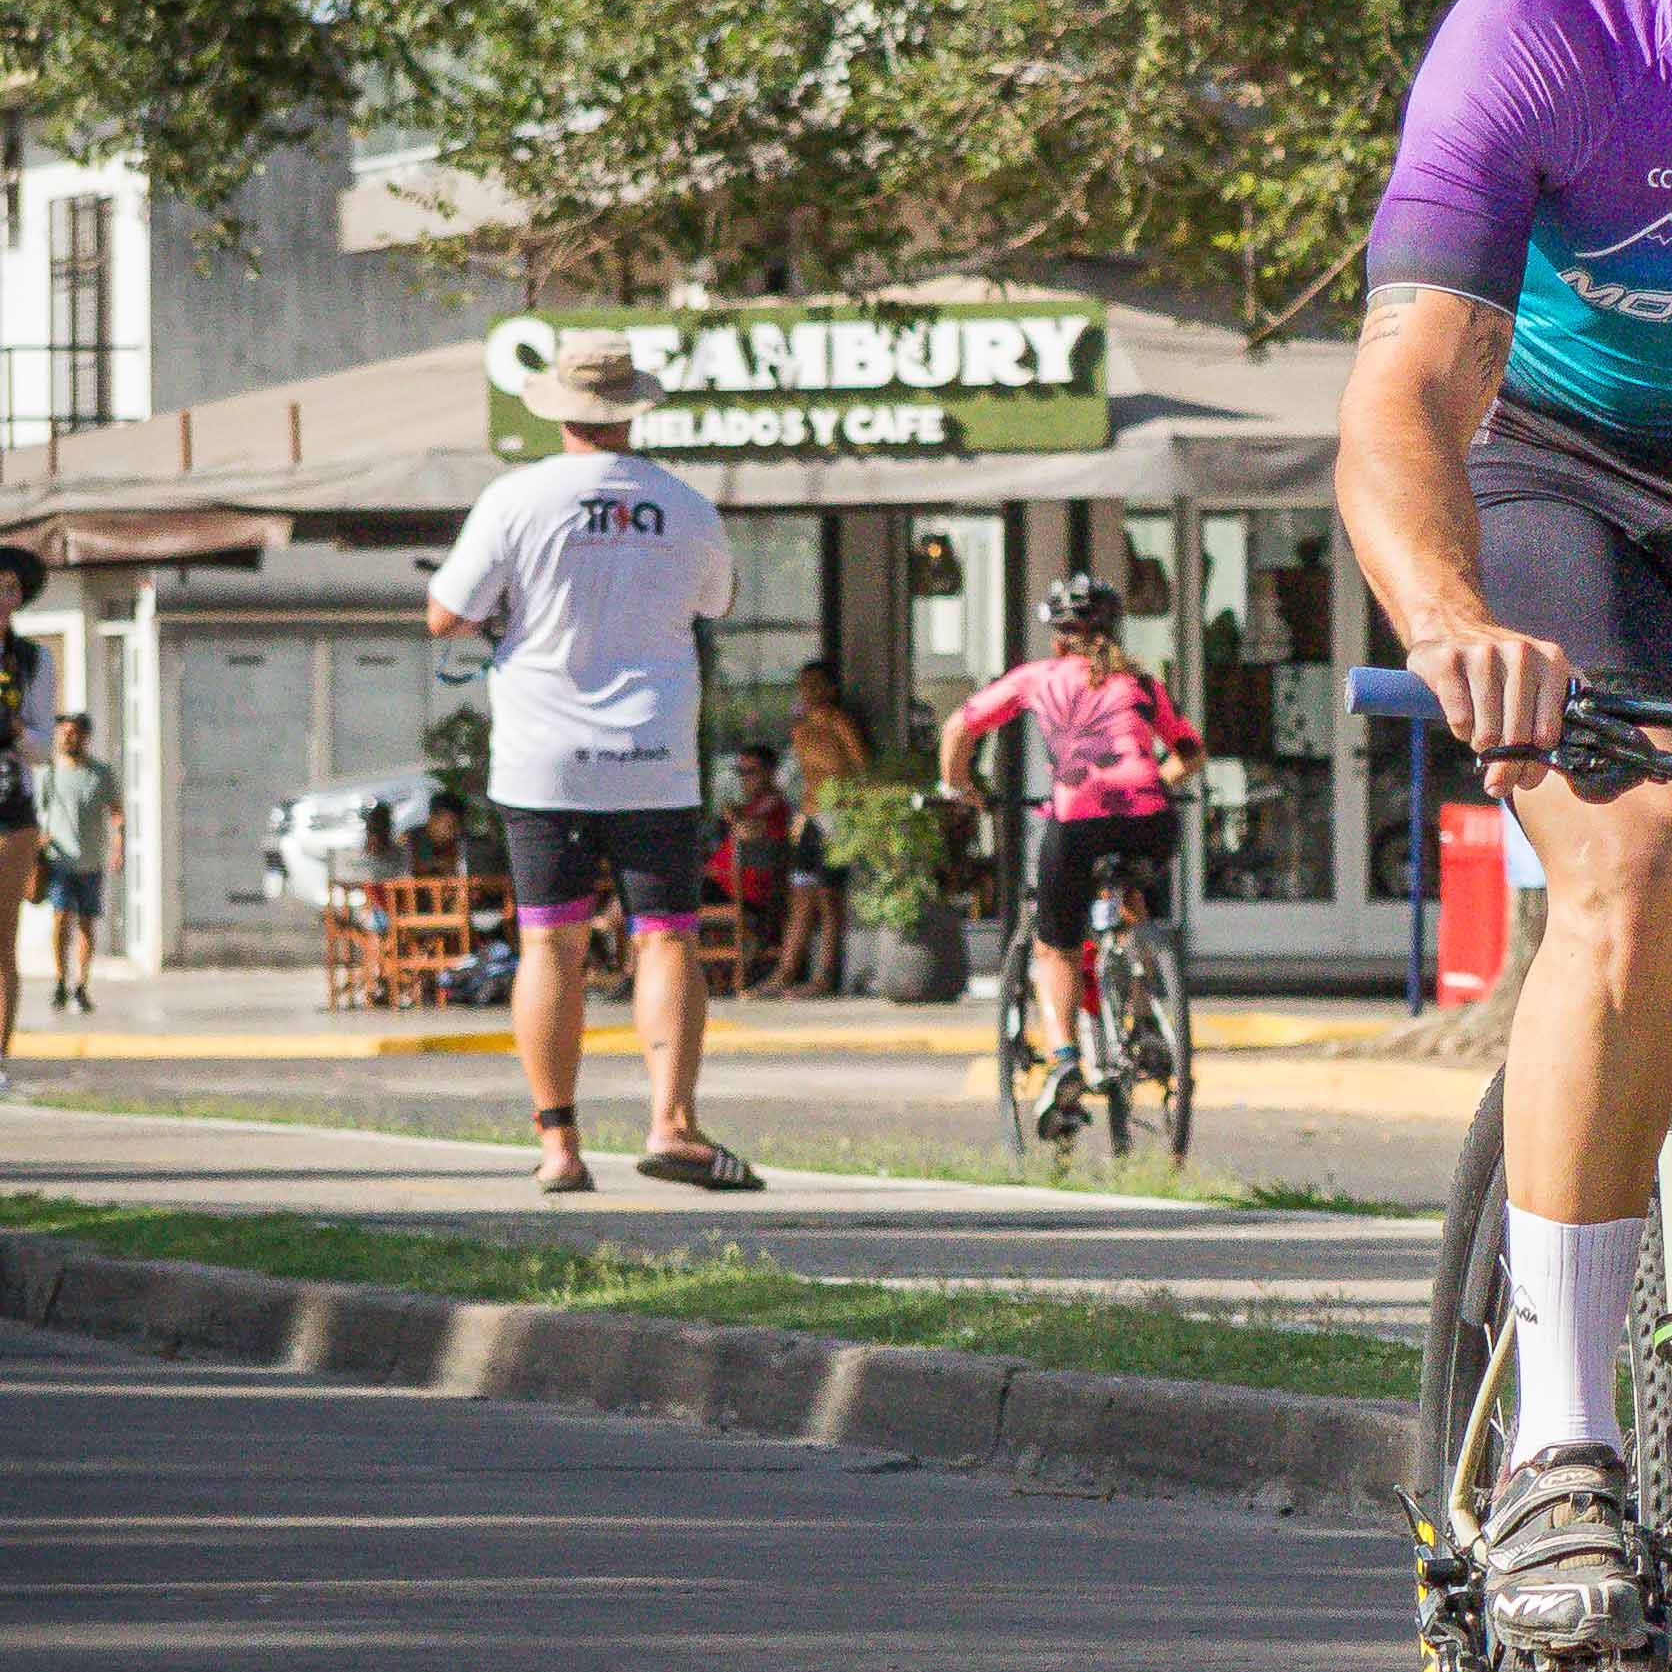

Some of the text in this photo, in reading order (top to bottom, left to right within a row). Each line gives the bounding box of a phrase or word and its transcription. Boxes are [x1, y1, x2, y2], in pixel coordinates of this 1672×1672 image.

[628, 403, 946, 449] HELADOS Y CAFE
